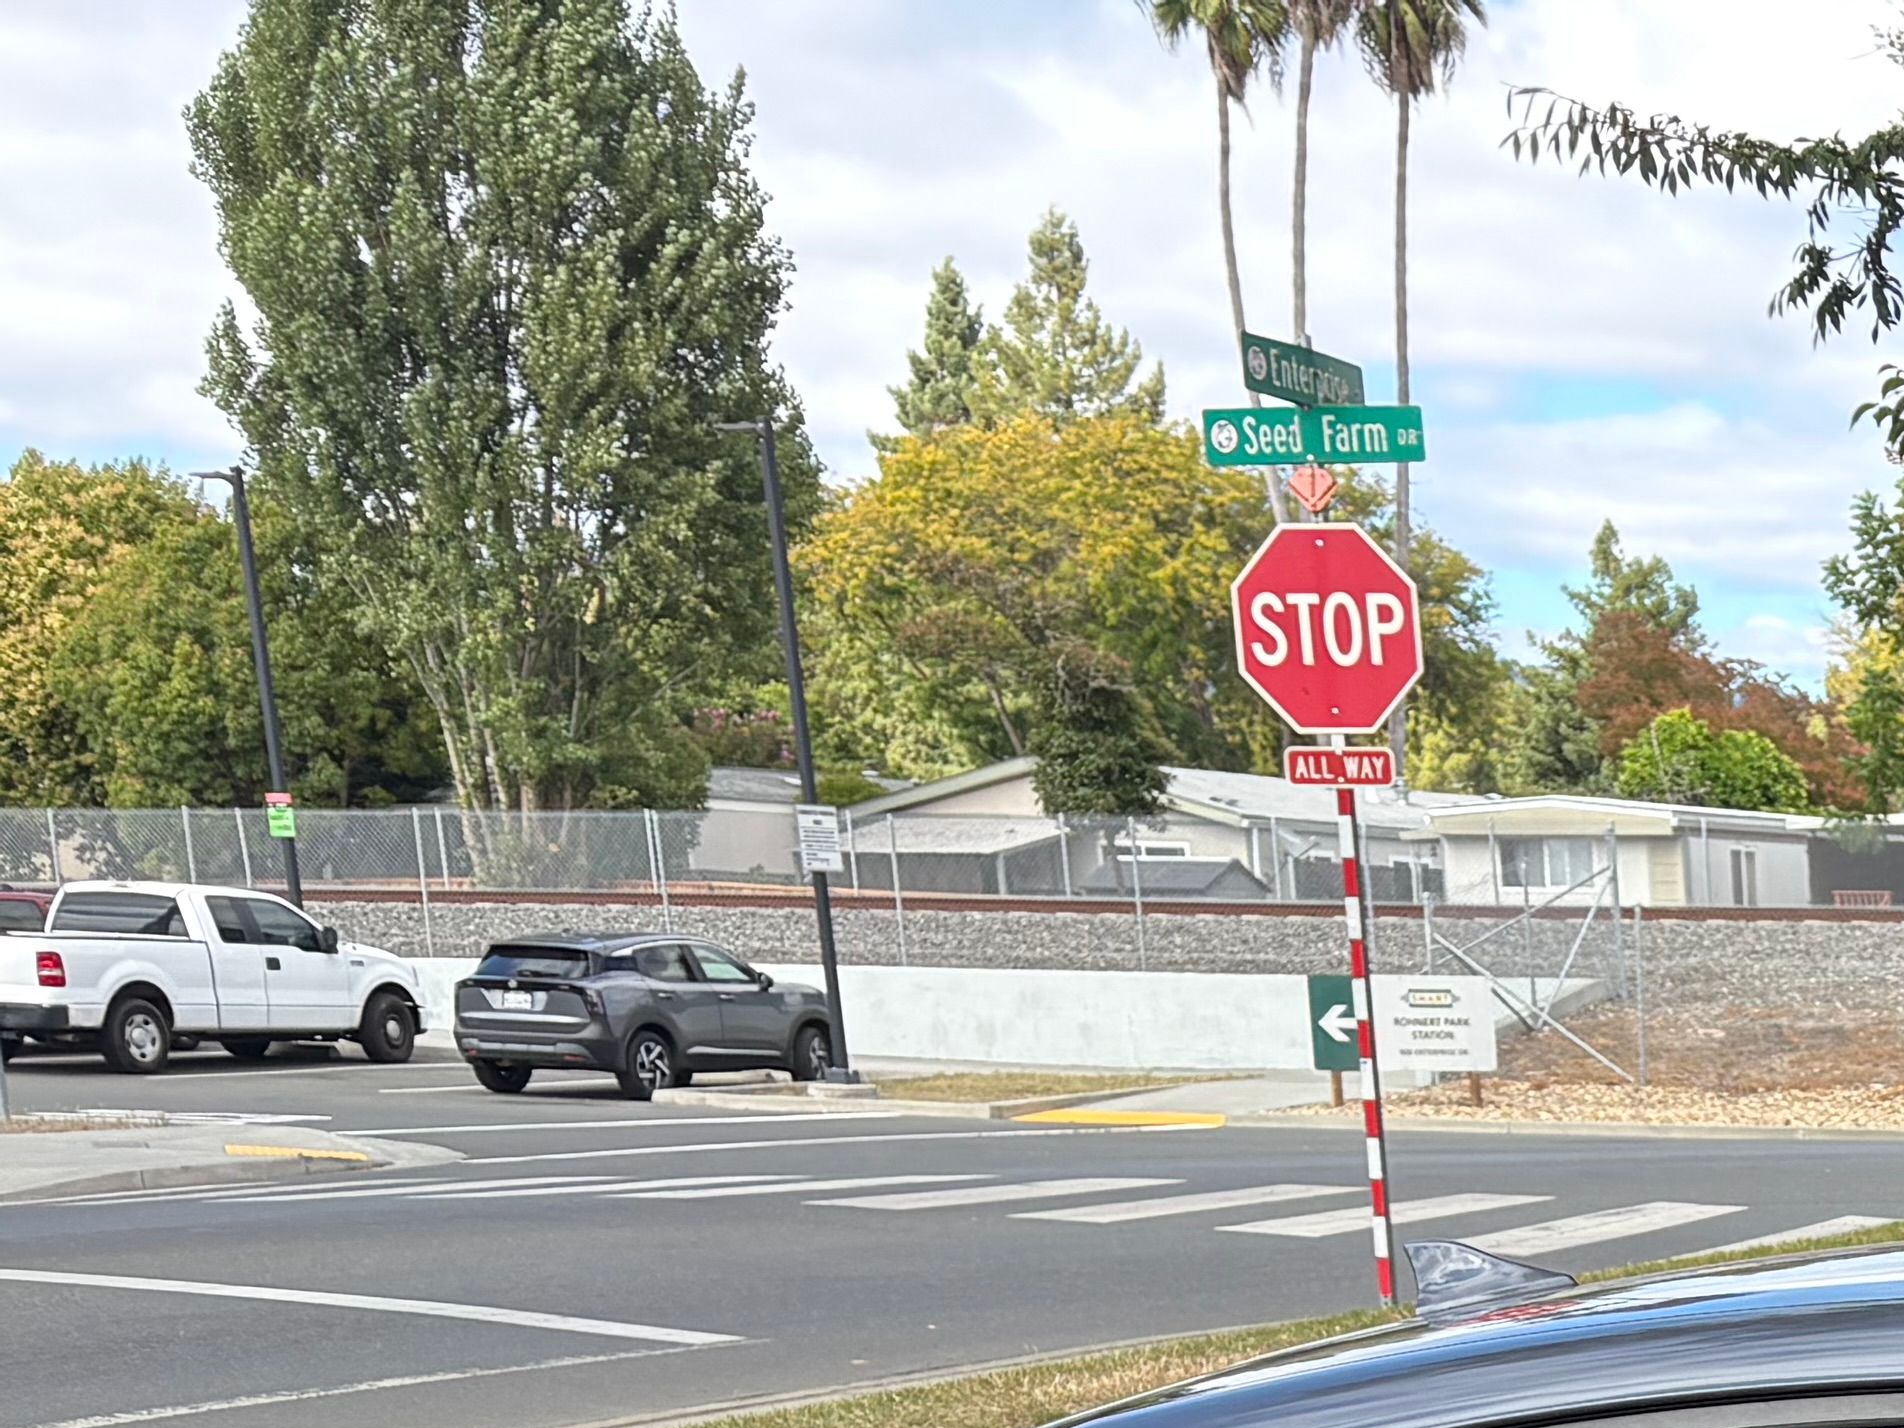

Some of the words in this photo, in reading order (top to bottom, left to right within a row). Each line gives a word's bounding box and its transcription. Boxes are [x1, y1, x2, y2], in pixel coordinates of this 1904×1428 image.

[1269, 348, 1350, 404] Enterprise
[1242, 415, 1304, 455] Seed
[1321, 414, 1389, 453] Farm
[1250, 591, 1405, 667] STOP
[1295, 755, 1336, 780] ALL
[1343, 755, 1386, 780] WAY
[1411, 1030, 1455, 1040] STATION
[1443, 1017, 1470, 1027] PARK
